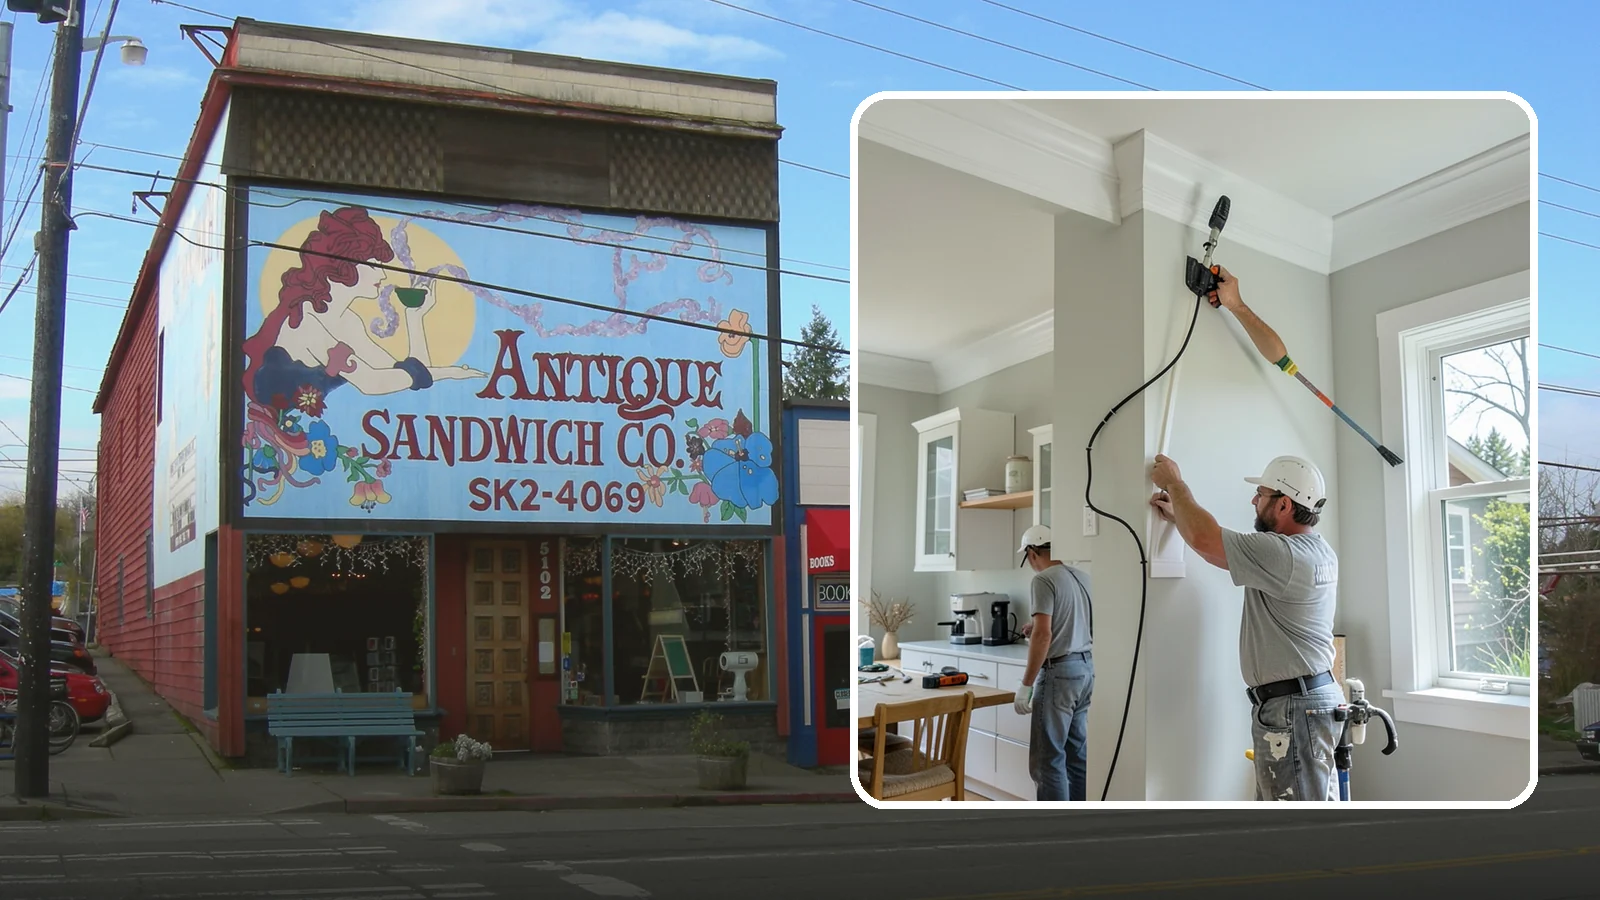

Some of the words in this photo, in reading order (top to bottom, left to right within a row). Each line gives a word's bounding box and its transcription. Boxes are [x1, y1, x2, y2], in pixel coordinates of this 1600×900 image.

[476, 329, 723, 420] ANTIQUE
[361, 408, 604, 467] SANDWICH
[617, 422, 685, 468] CO.
[468, 477, 645, 513] SK2-4069
[540, 542, 551, 599] 5102
[809, 555, 835, 568] BOOKS
